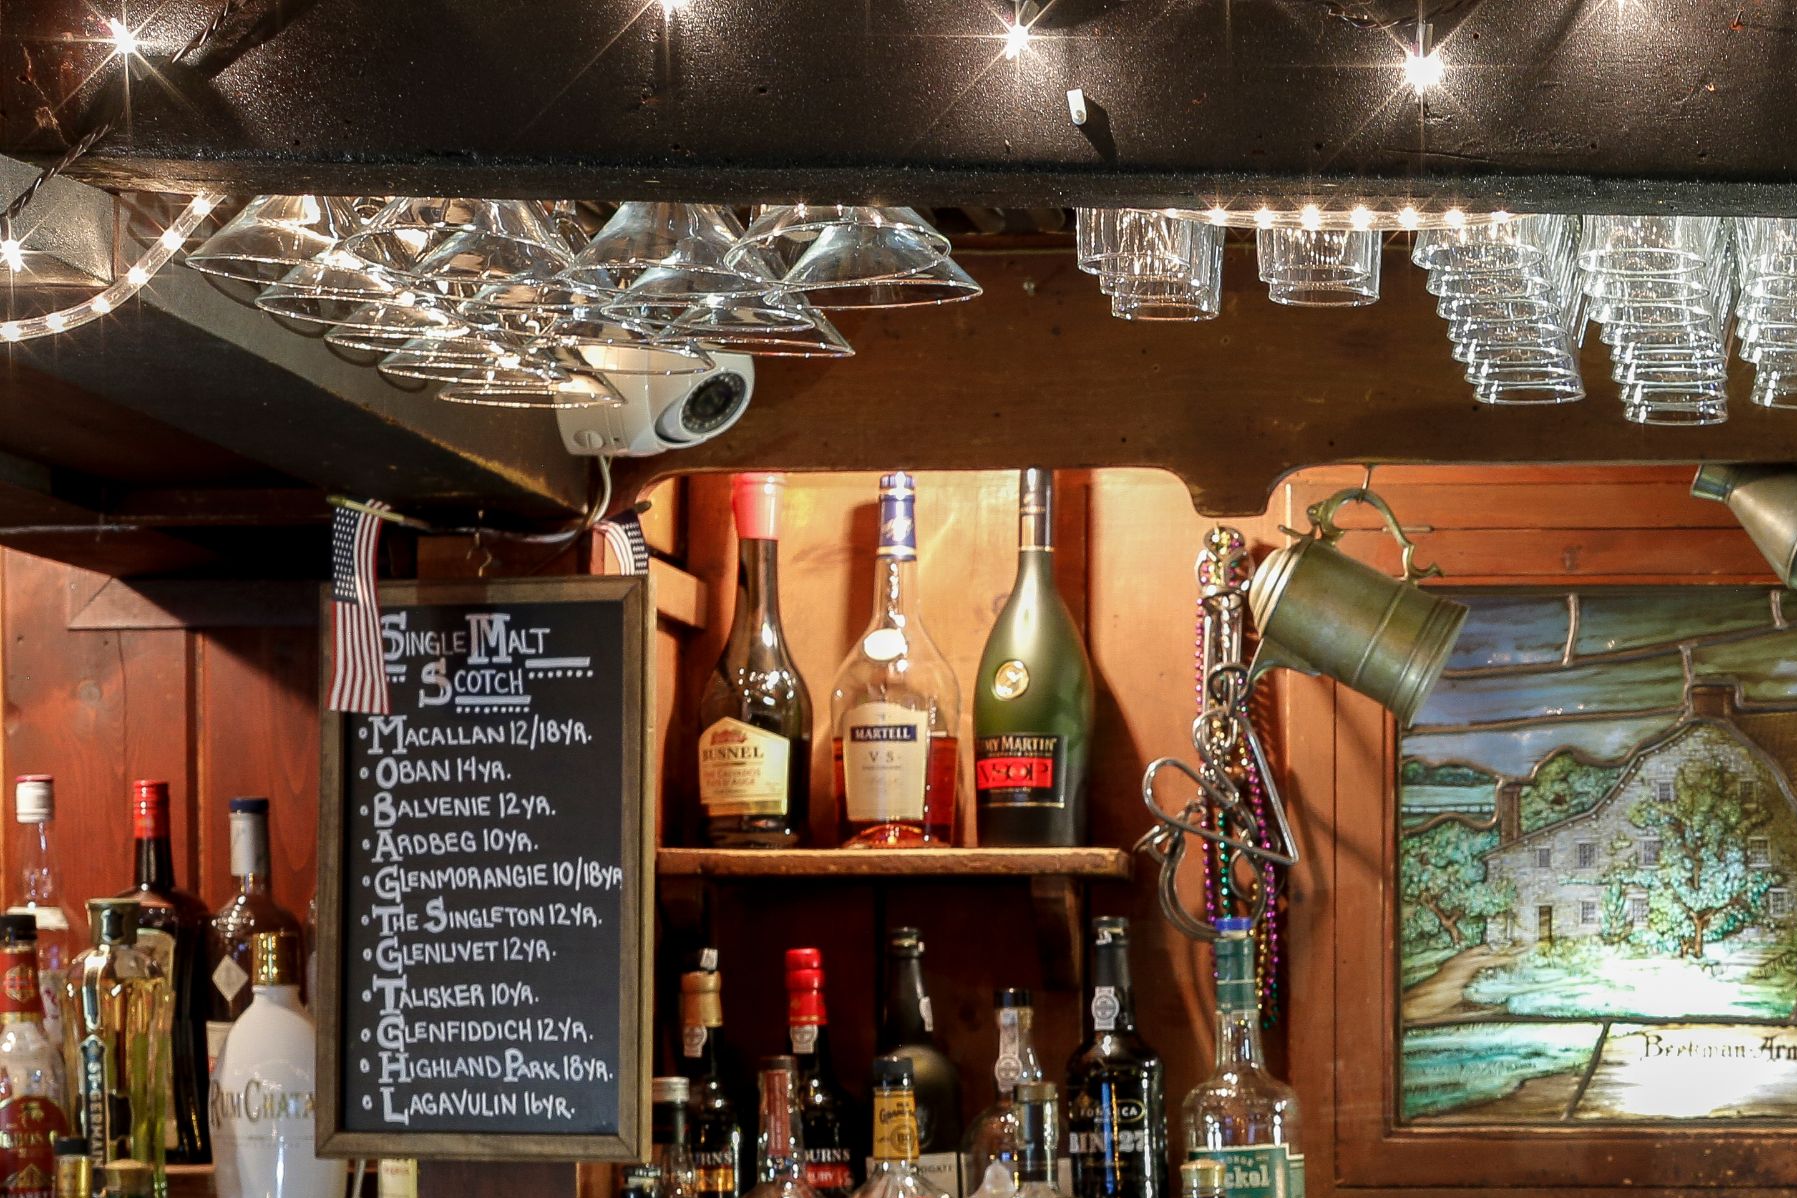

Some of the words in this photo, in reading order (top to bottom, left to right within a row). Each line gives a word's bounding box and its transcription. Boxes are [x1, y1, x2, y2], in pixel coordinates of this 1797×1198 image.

[380, 610, 467, 661] SINGLE
[465, 613, 550, 664] MALT
[419, 658, 524, 707] SCOTCH
[367, 715, 504, 754] MACALLAN
[855, 727, 911, 740] MARTELL
[1001, 735, 1055, 752] MARTIN
[376, 757, 450, 789] OBAN
[374, 792, 491, 828] BALVENIE
[372, 828, 477, 863] ARDBEG
[374, 865, 548, 902] GLENMORANGIE
[372, 904, 418, 936] THE
[423, 896, 544, 933] SINGLETON
[375, 937, 498, 974] GLENLIVET
[373, 974, 485, 1015] TALISKER
[376, 1015, 532, 1052] GLENFIDDICH
[378, 1051, 500, 1084] HIGHLAND
[504, 1048, 560, 1082] PARK
[379, 1086, 516, 1125] LAGAVULIN
[1224, 1165, 1269, 1188] ckel
